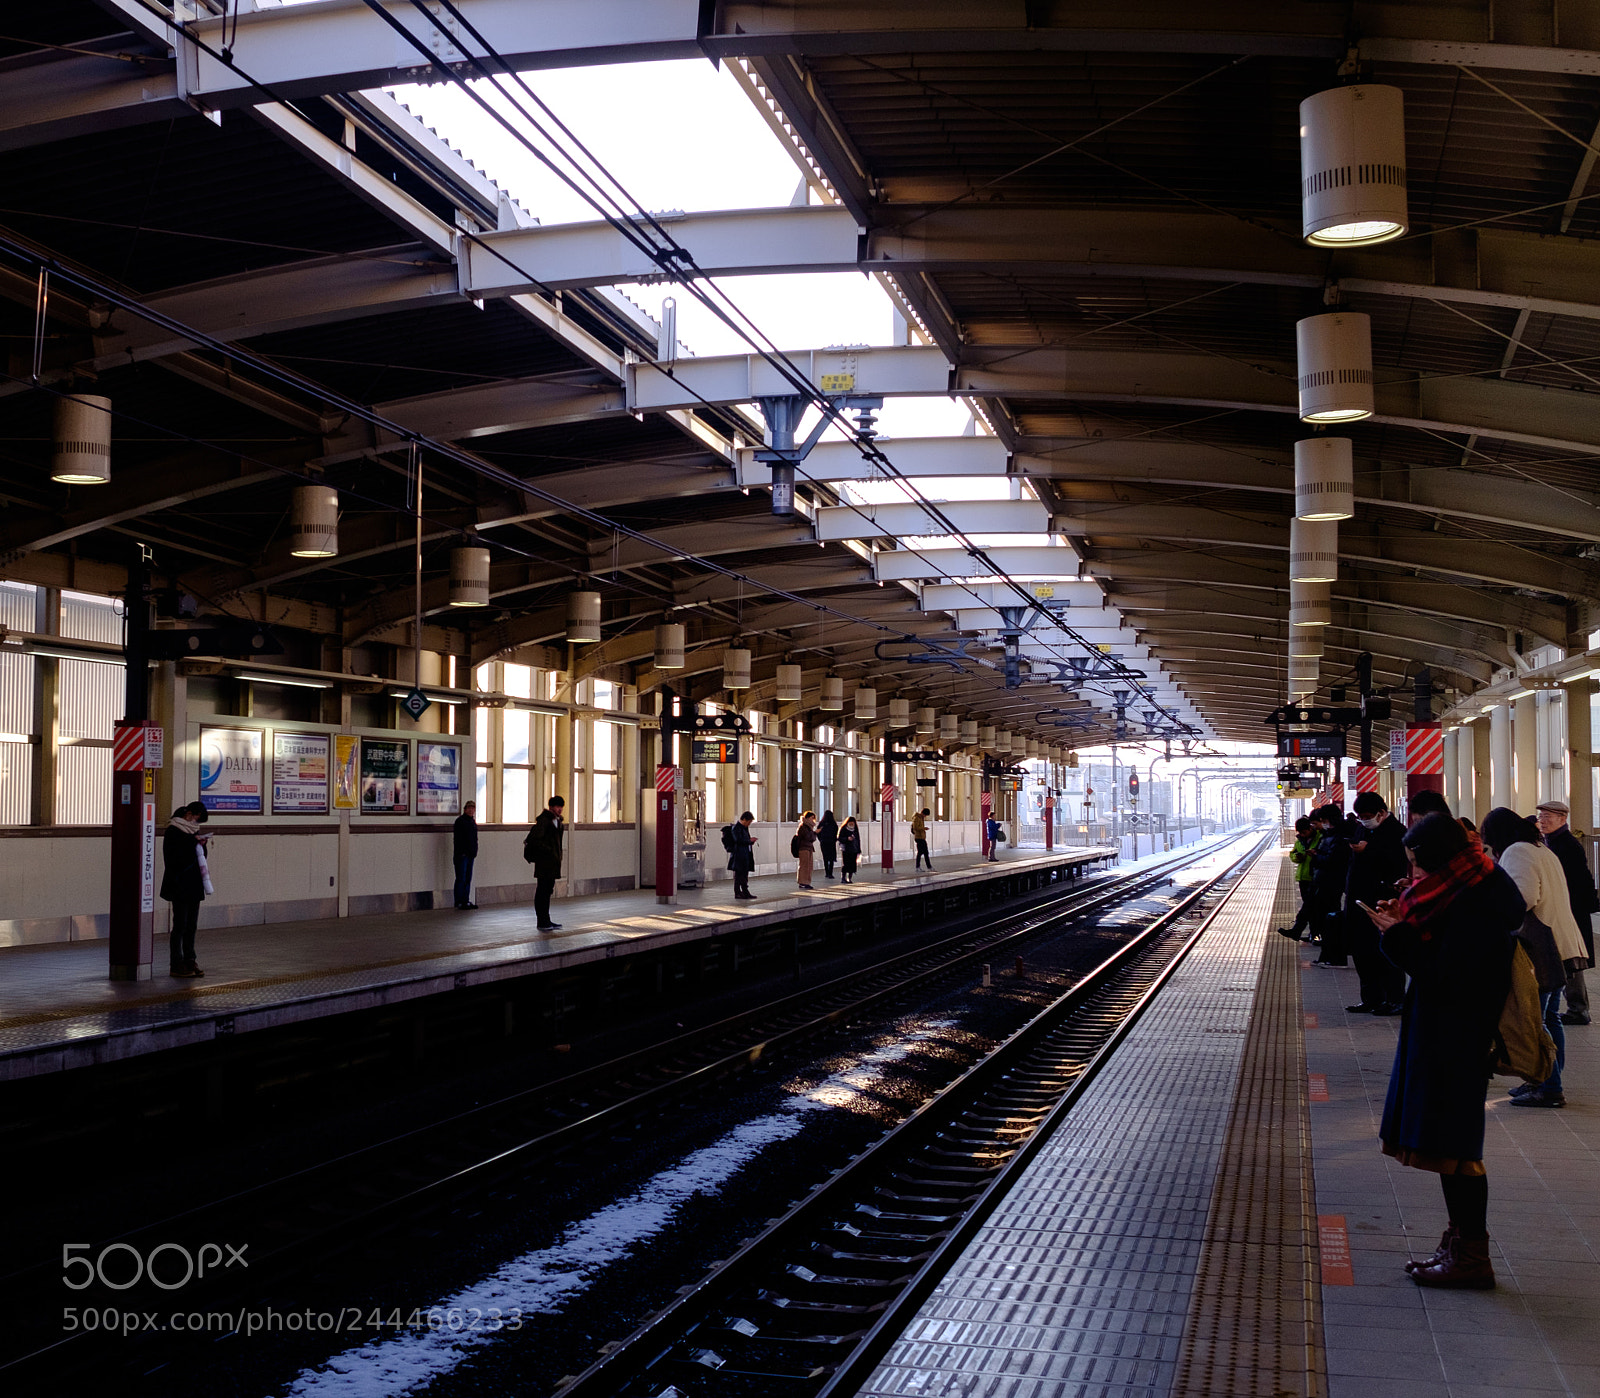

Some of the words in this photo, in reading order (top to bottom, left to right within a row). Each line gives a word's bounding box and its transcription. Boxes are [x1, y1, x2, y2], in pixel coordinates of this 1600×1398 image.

[410, 698, 421, 710] 6
[726, 743, 735, 755] 2
[1283, 738, 1290, 753] 1
[226, 756, 258, 771] DAIKI
